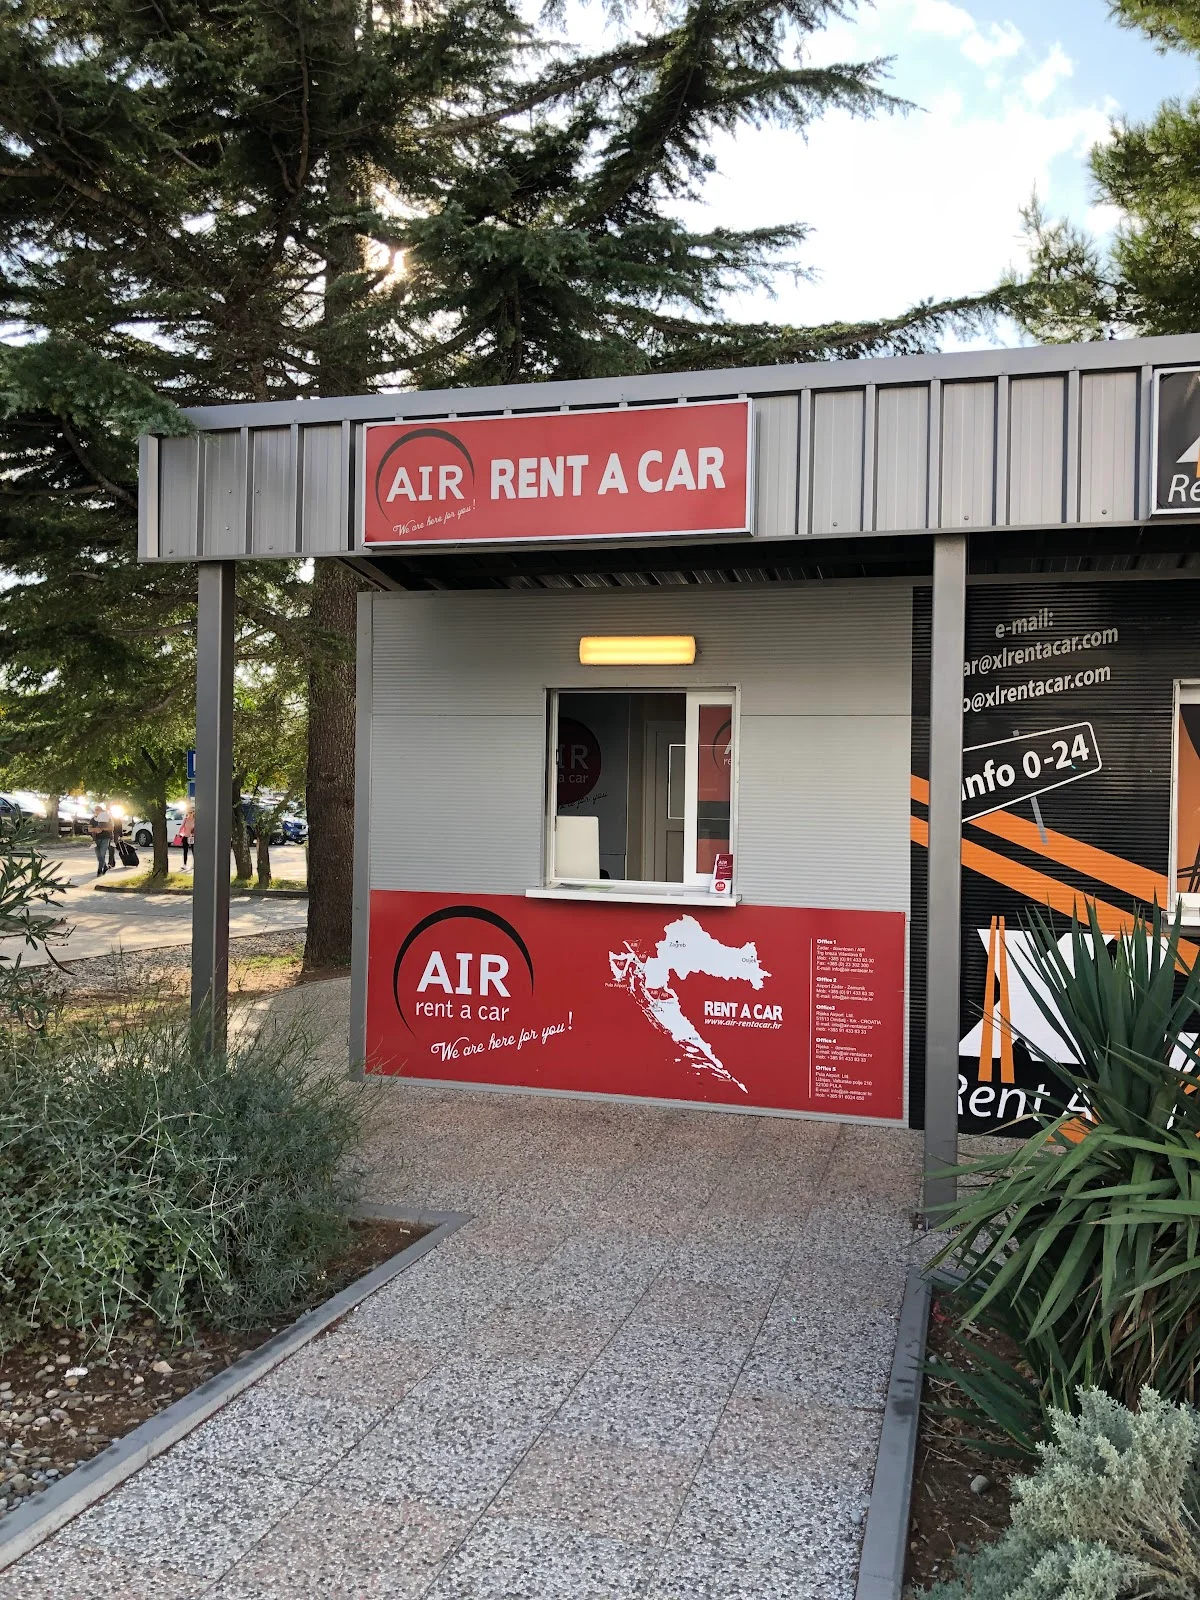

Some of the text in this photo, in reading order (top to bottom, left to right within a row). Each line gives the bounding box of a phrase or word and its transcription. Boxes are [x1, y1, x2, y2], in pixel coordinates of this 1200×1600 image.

[386, 447, 725, 503] AIR RENT A CAR
[1168, 474, 1200, 503] Re
[392, 499, 476, 536] We are here for you!
[995, 608, 1054, 638] e-mail:
[963, 627, 1119, 677] ar@xlrentacar.com
[963, 666, 1111, 712] o@xlrentacar.com
[558, 744, 589, 770] IR
[1023, 734, 1089, 779] 0-24
[568, 774, 588, 784] car
[416, 951, 511, 997] AIR
[416, 1000, 509, 1022] rent a car
[705, 1001, 783, 1021] RENT A CAR
[705, 1018, 782, 1030] www.air-rentacar.hr
[431, 1011, 573, 1061] We are here for you!
